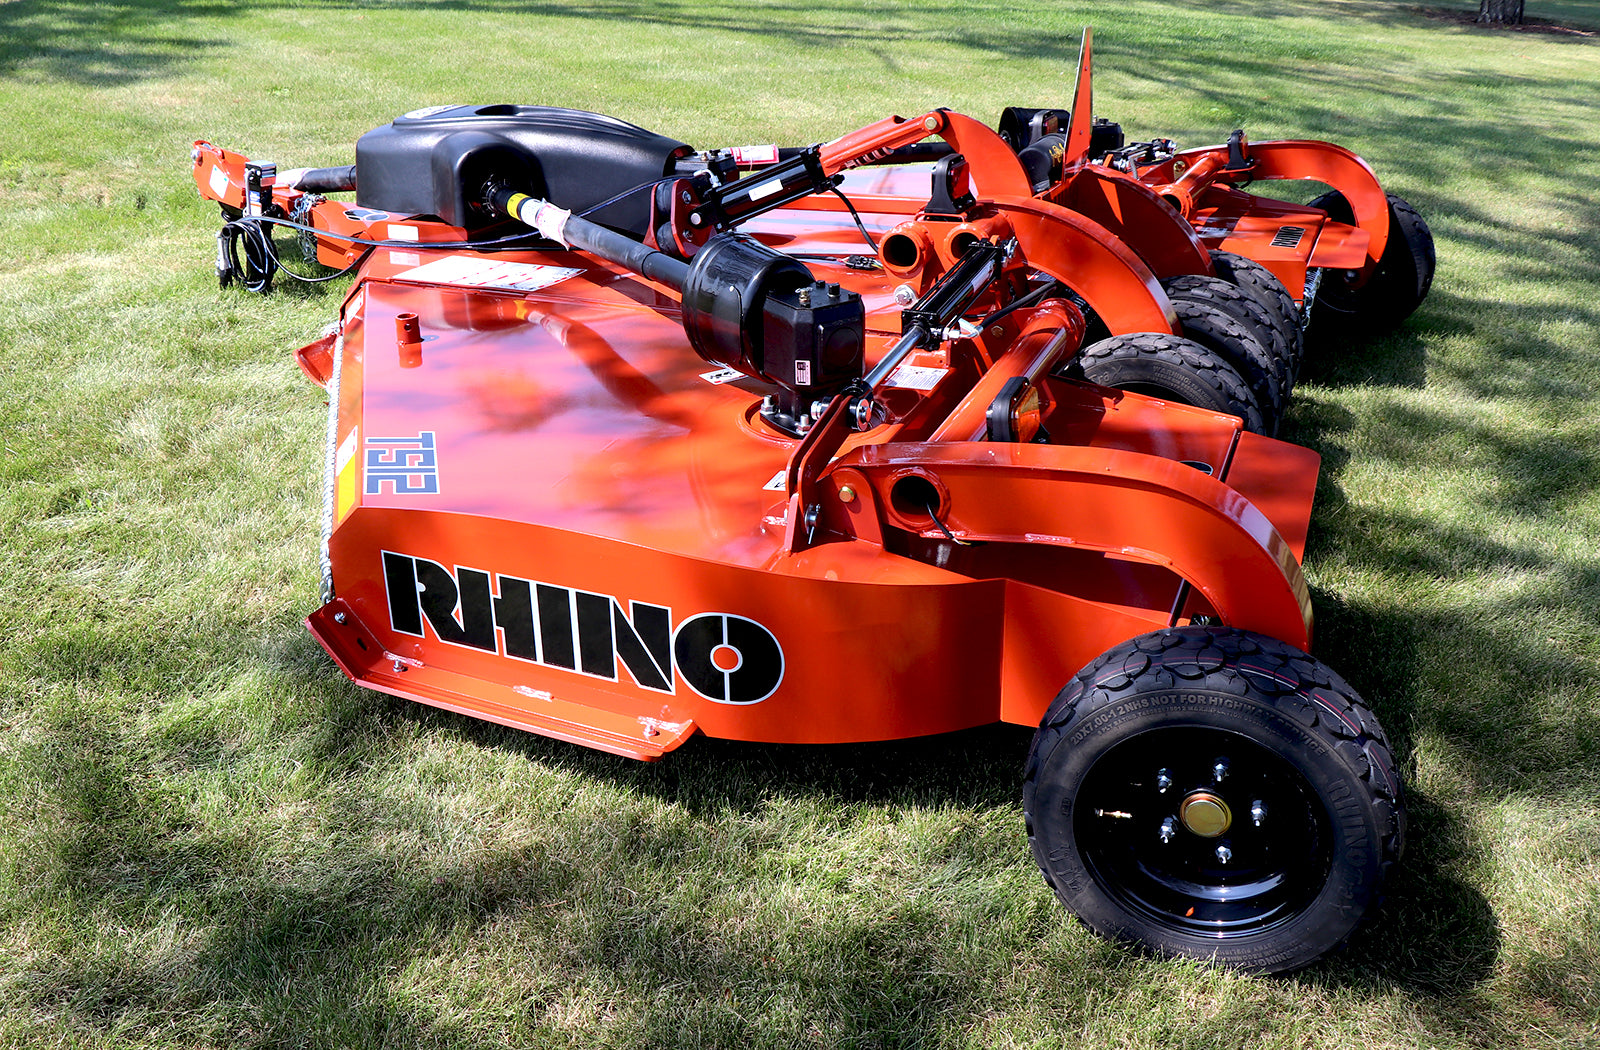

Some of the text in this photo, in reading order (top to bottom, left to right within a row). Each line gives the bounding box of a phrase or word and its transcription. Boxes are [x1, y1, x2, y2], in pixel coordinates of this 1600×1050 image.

[364, 430, 440, 496] TS12
[381, 550, 785, 706] RHINO
[1149, 694, 1177, 706] NOT
[1179, 694, 1206, 704] FOR
[1208, 695, 1275, 723] HIGHWAY
[1273, 717, 1325, 756] SERVICE
